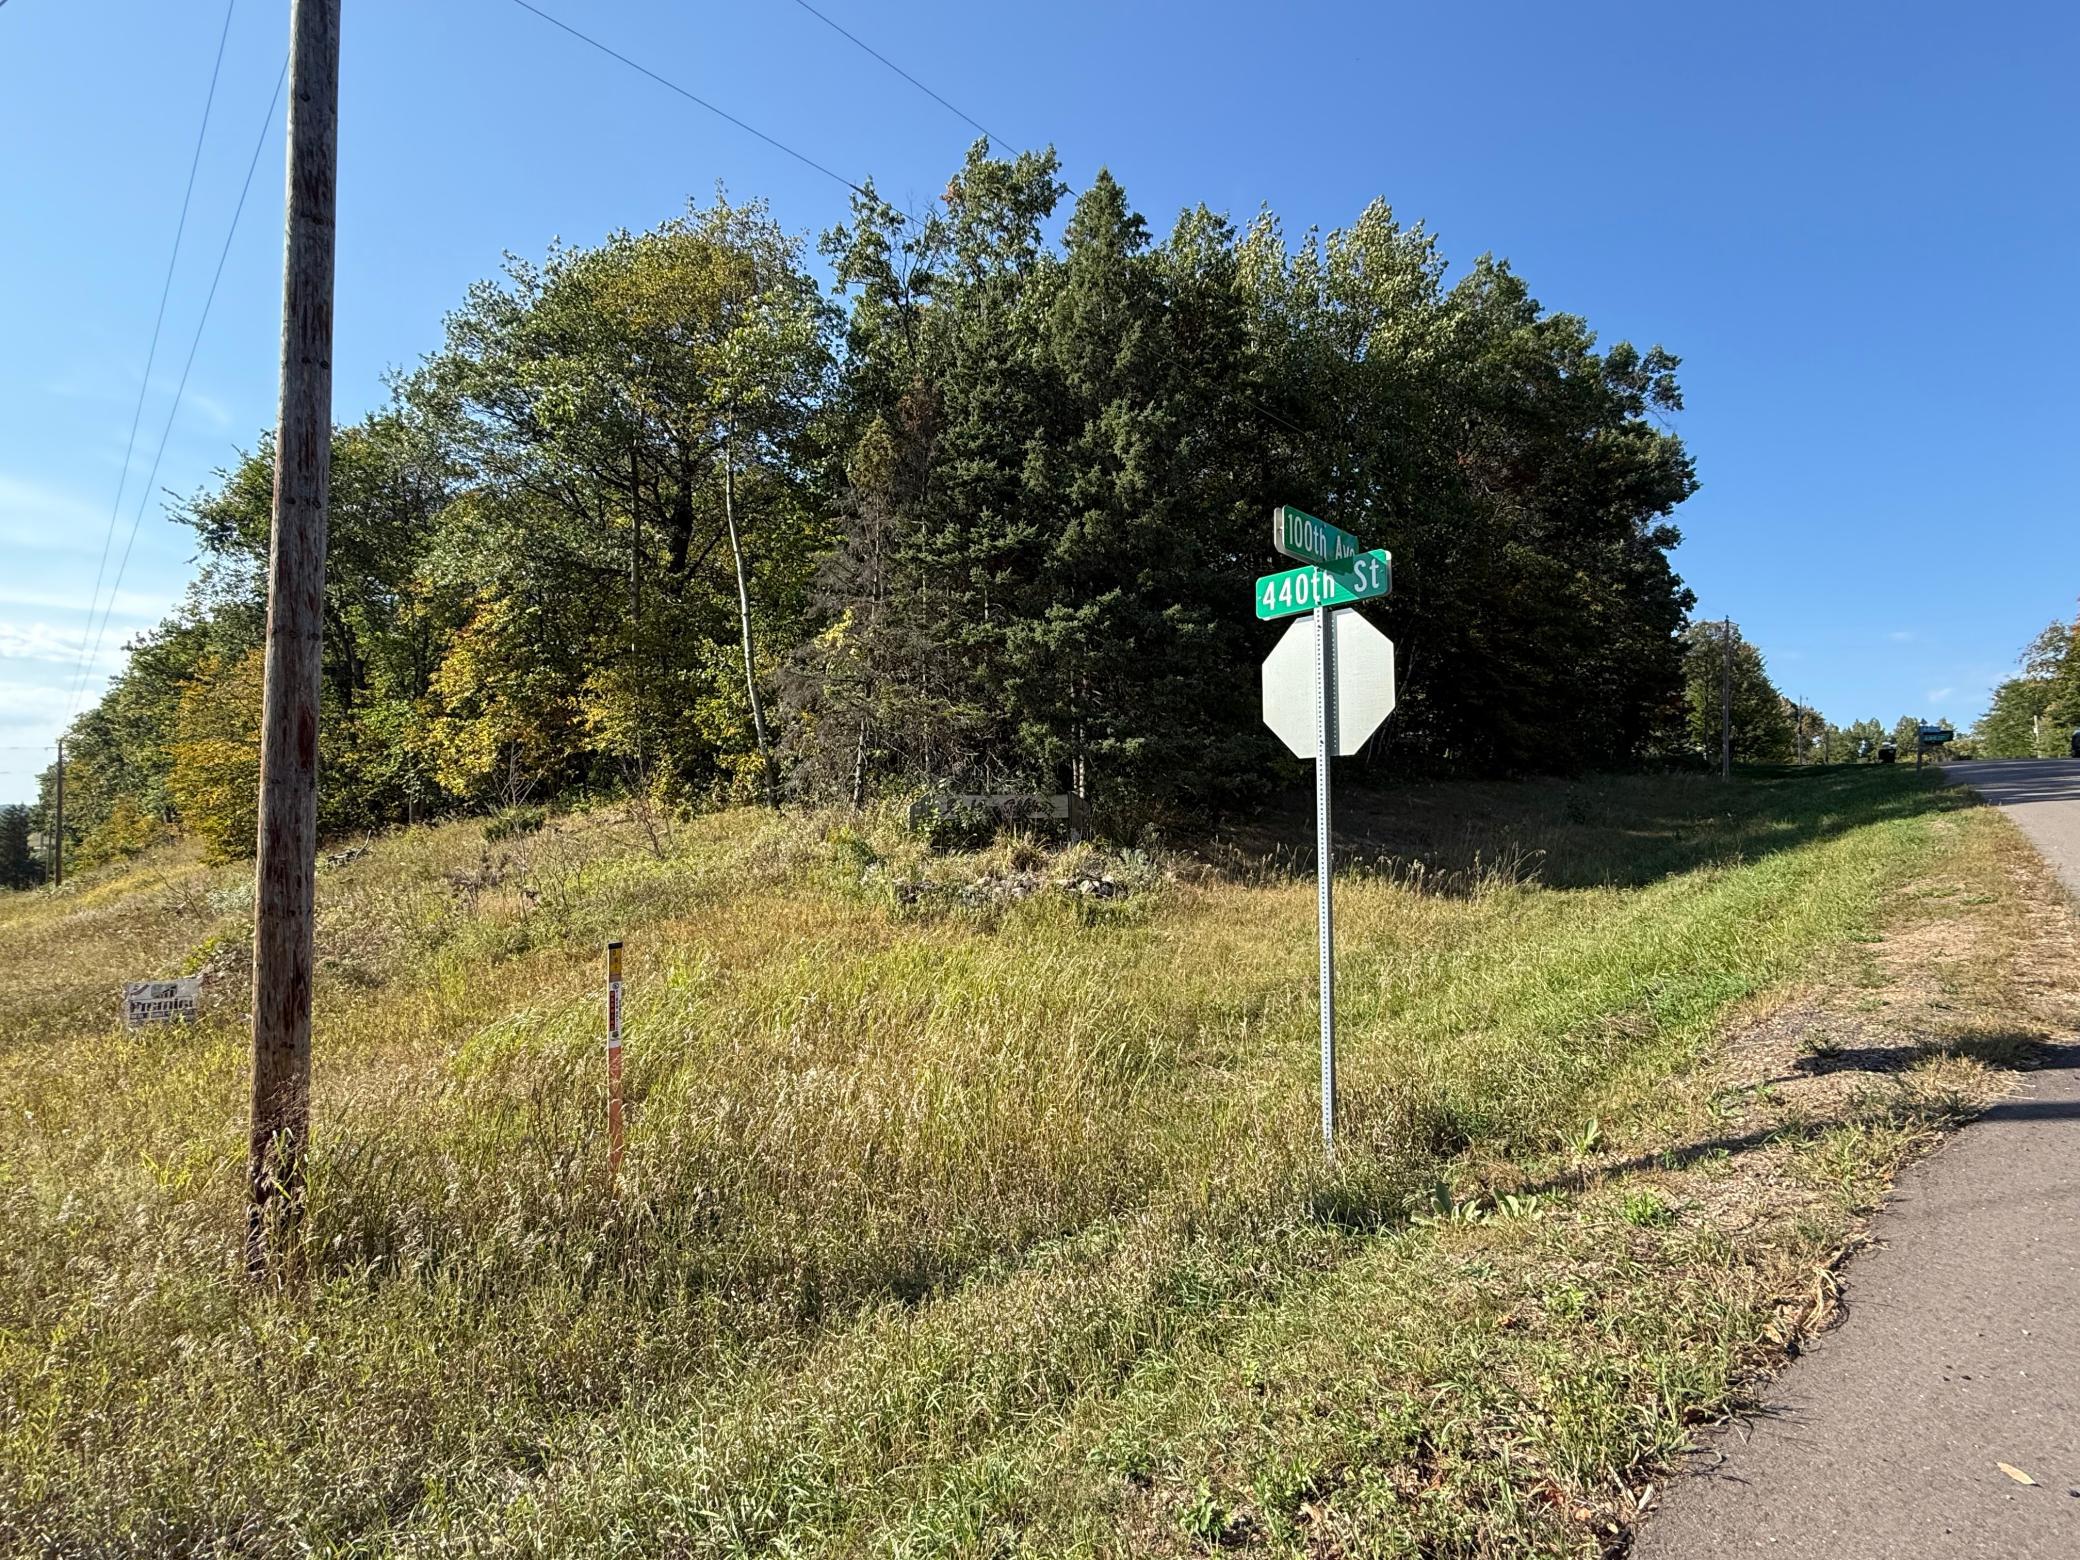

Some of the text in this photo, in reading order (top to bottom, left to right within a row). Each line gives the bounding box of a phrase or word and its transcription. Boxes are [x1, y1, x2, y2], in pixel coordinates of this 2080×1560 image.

[1288, 514, 1327, 561] 100th
[1262, 559, 1380, 610] 440th St
